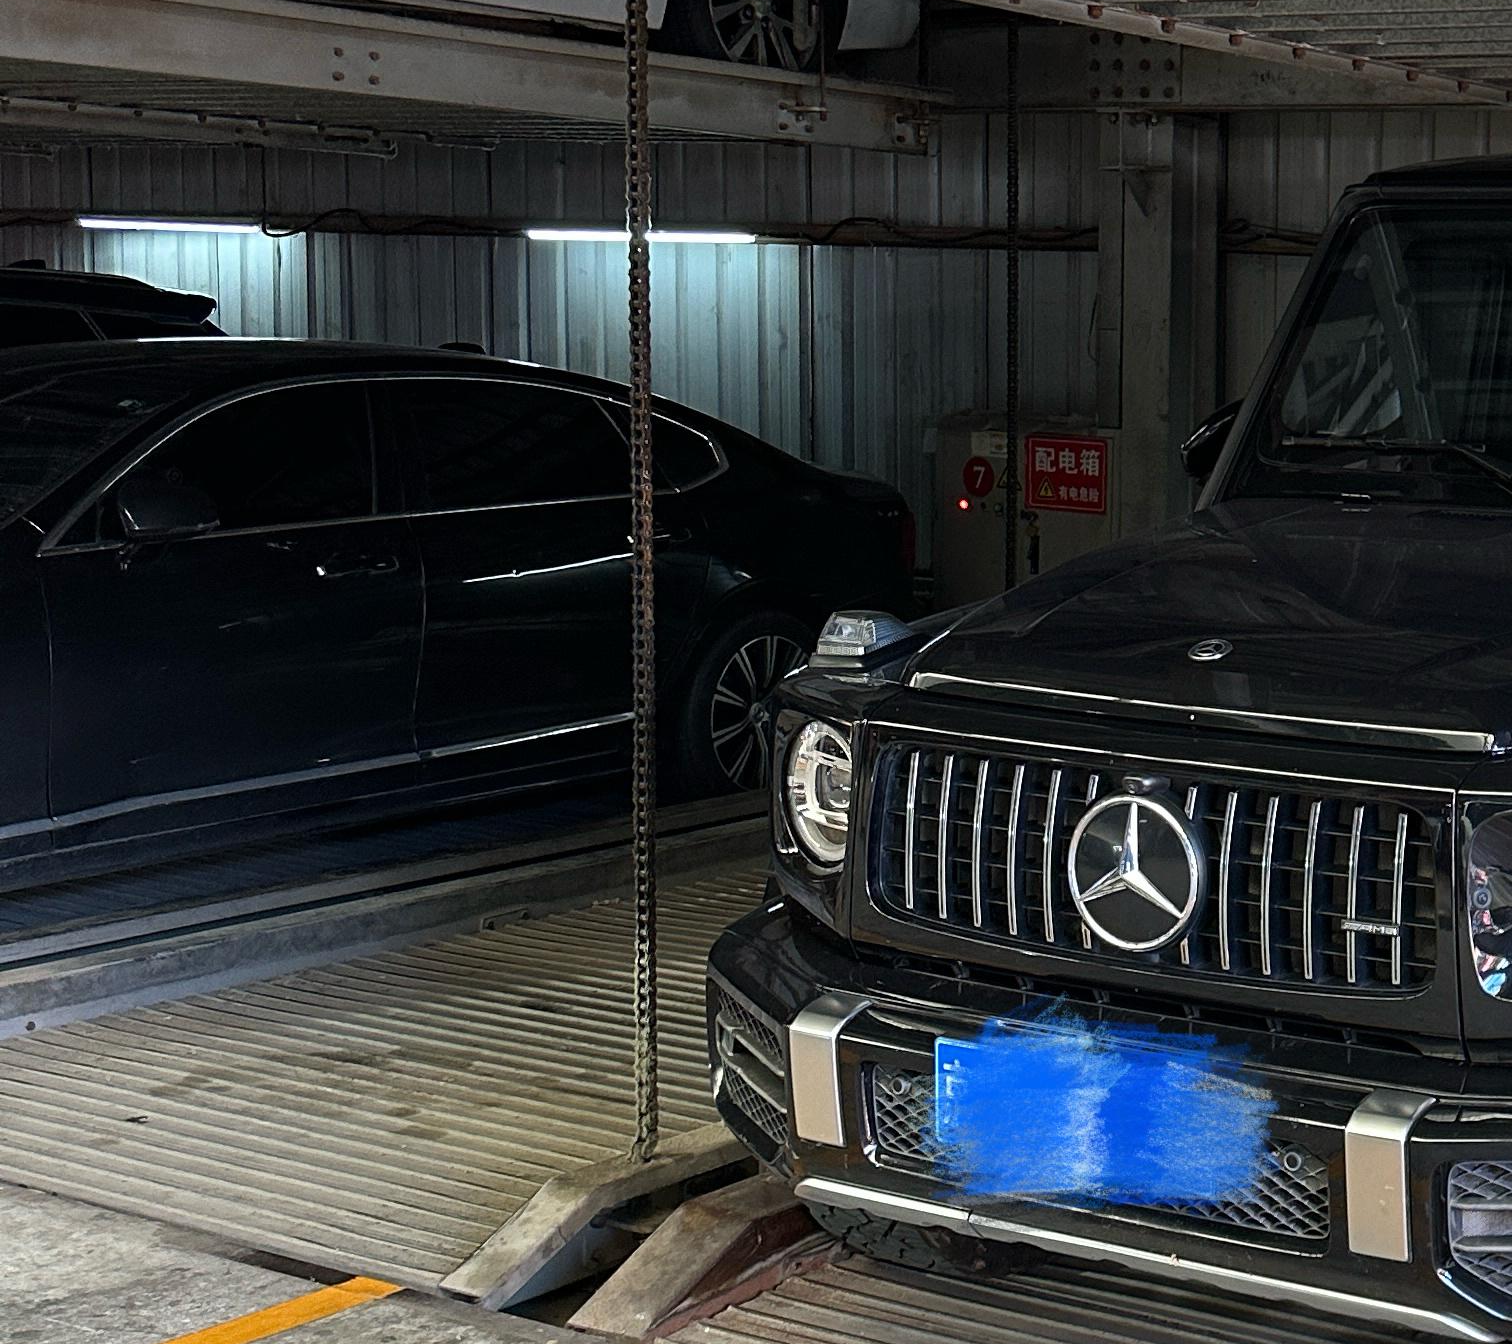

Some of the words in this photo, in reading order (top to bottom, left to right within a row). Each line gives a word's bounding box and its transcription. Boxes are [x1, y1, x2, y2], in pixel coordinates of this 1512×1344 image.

[1034, 446, 1101, 477] 配电箱
[973, 465, 986, 489] 7
